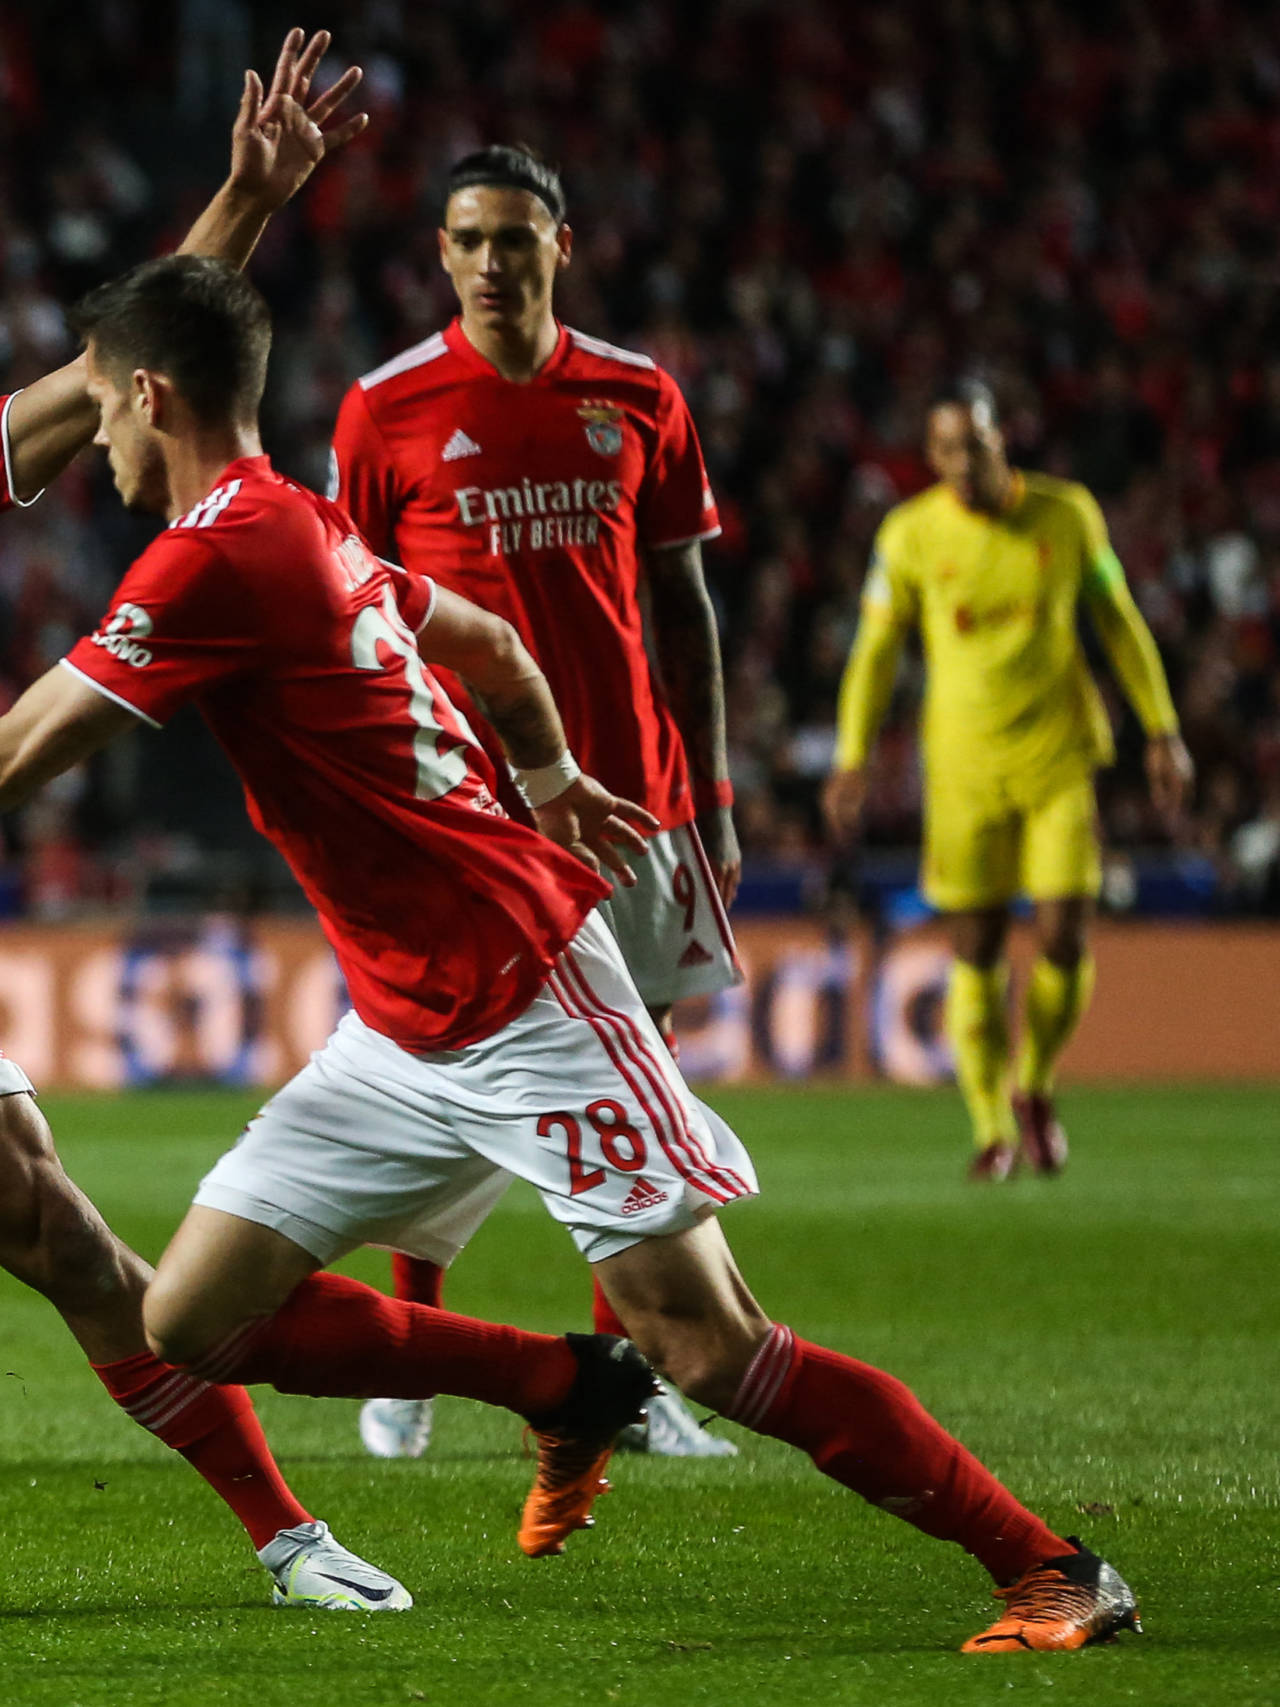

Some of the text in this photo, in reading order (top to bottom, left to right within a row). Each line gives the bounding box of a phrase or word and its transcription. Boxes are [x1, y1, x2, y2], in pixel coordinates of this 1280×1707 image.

[454, 477, 622, 526] Emirates
[490, 515, 599, 557] FLY BETTER
[672, 862, 697, 934] 9
[536, 1098, 648, 1196] 28
[622, 1192, 669, 1214] adidas
